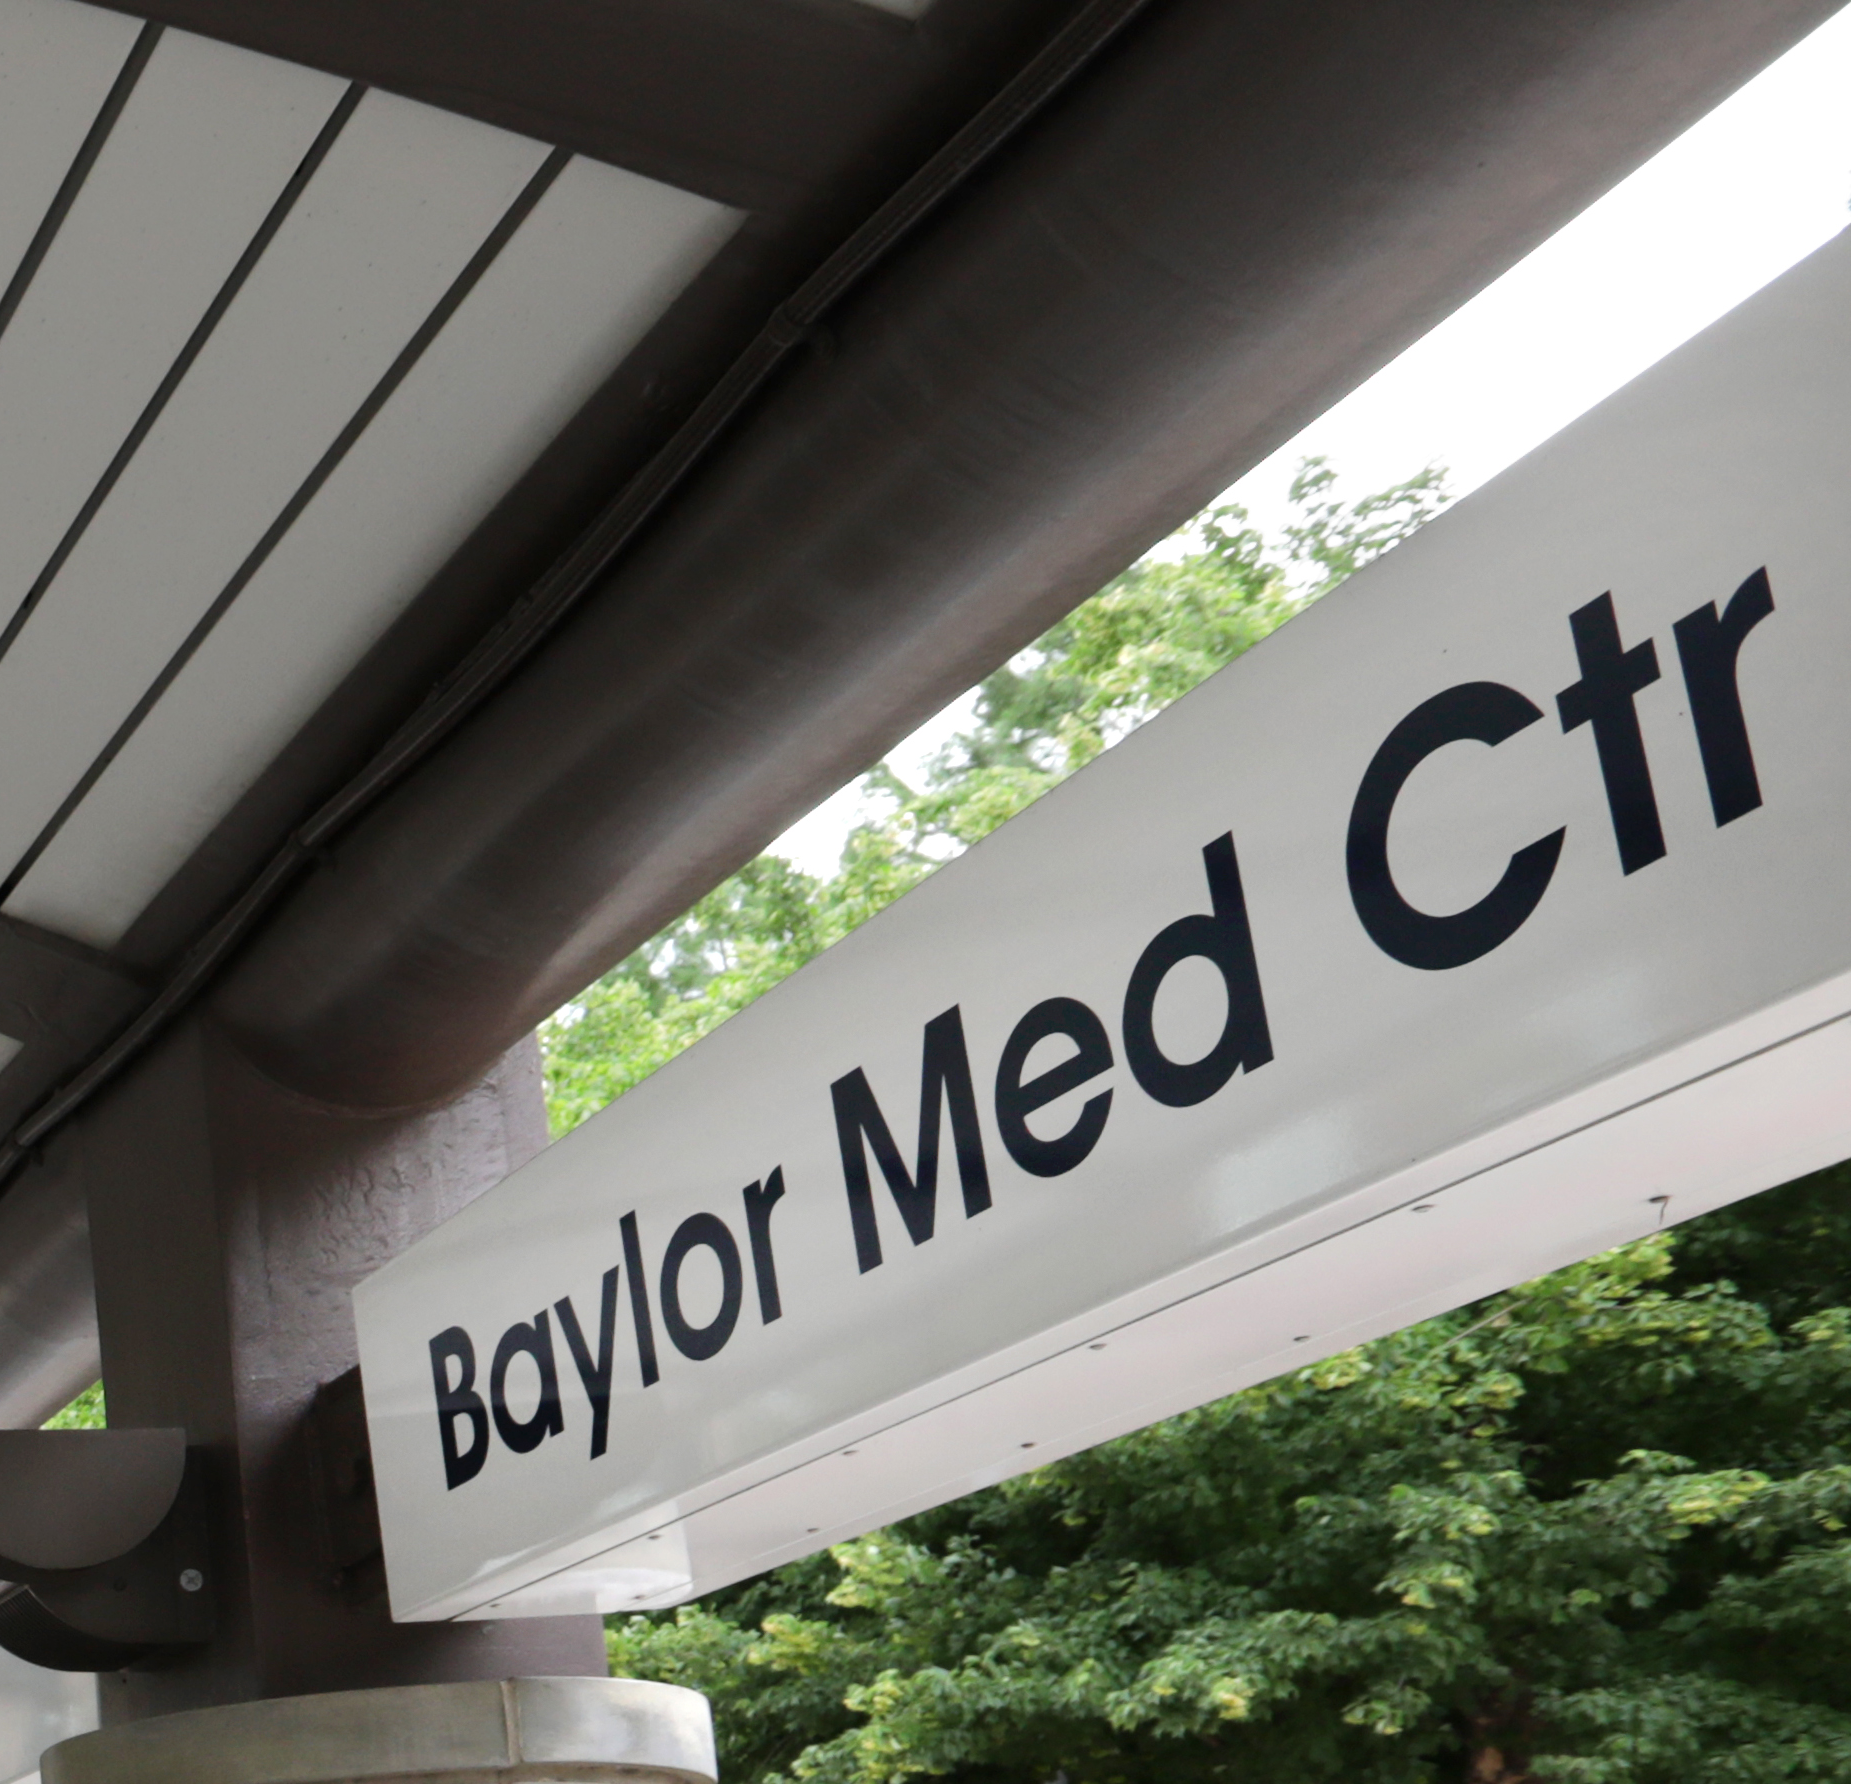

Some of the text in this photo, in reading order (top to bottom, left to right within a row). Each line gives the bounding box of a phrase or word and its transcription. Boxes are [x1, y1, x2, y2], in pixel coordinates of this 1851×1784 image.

[429, 564, 1775, 1492] Baylor Med Ctr
